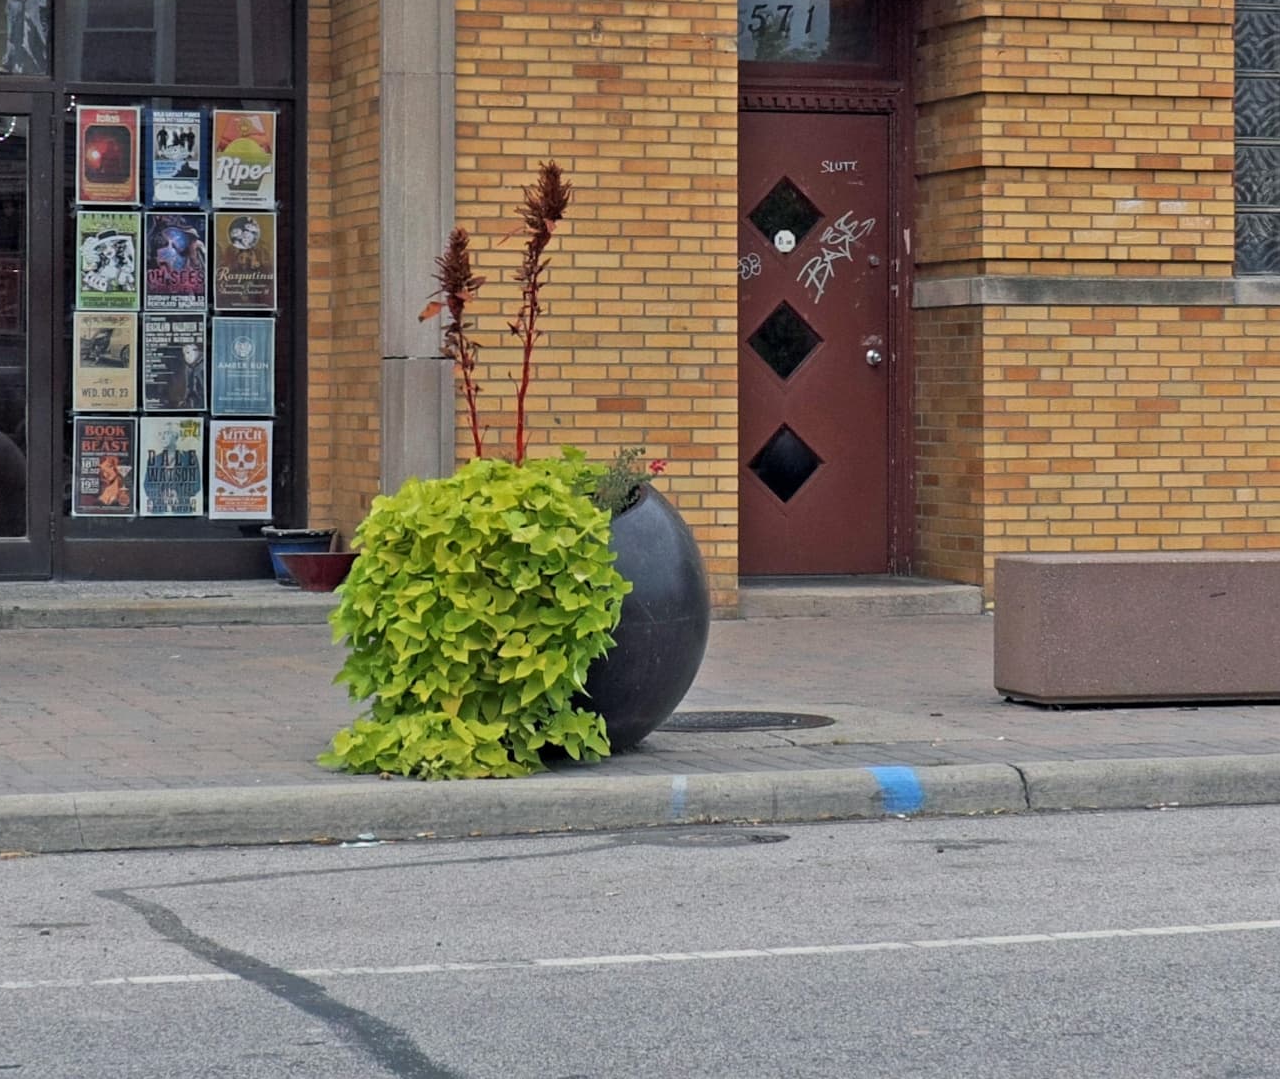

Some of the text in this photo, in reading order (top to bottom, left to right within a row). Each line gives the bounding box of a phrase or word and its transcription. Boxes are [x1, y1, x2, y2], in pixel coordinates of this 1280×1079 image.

[216, 156, 273, 186] Ripe
[84, 425, 126, 436] BOOK
[222, 430, 261, 440] WITCH
[82, 441, 129, 452] BEAST
[148, 449, 197, 466] DALE
[148, 467, 197, 482] WATSON
